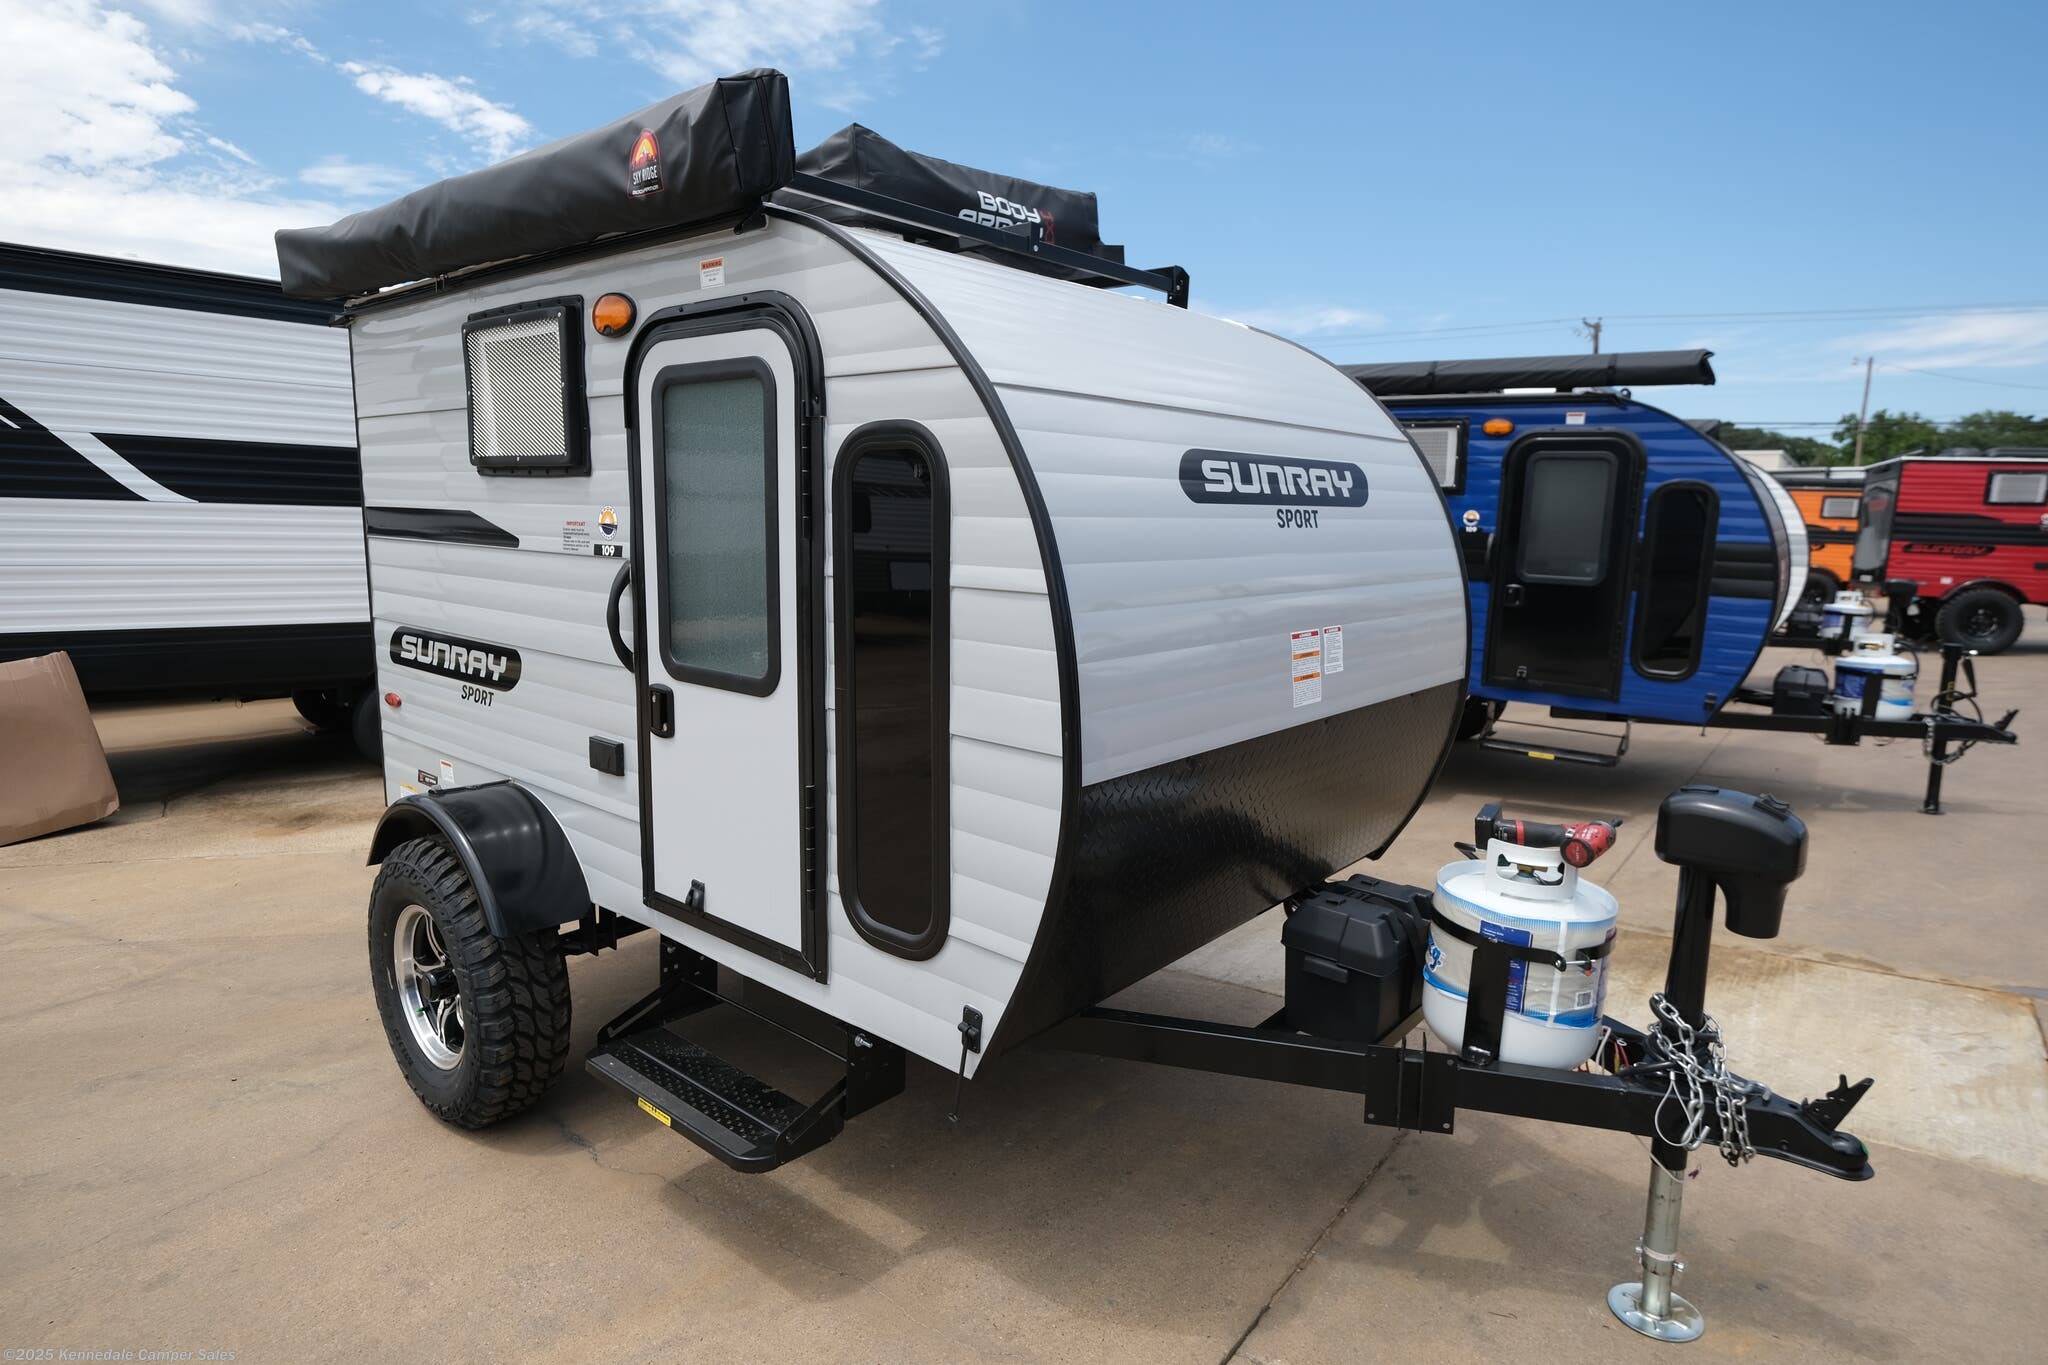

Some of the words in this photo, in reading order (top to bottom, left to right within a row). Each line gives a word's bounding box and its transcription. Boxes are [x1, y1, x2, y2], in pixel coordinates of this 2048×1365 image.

[977, 190, 1041, 224] BODY
[1201, 459, 1354, 498] SUNRAY
[1276, 508, 1319, 529] SPORT
[601, 545, 615, 557] 109
[400, 634, 507, 681] SUNRAY
[461, 685, 494, 707] SPORT
